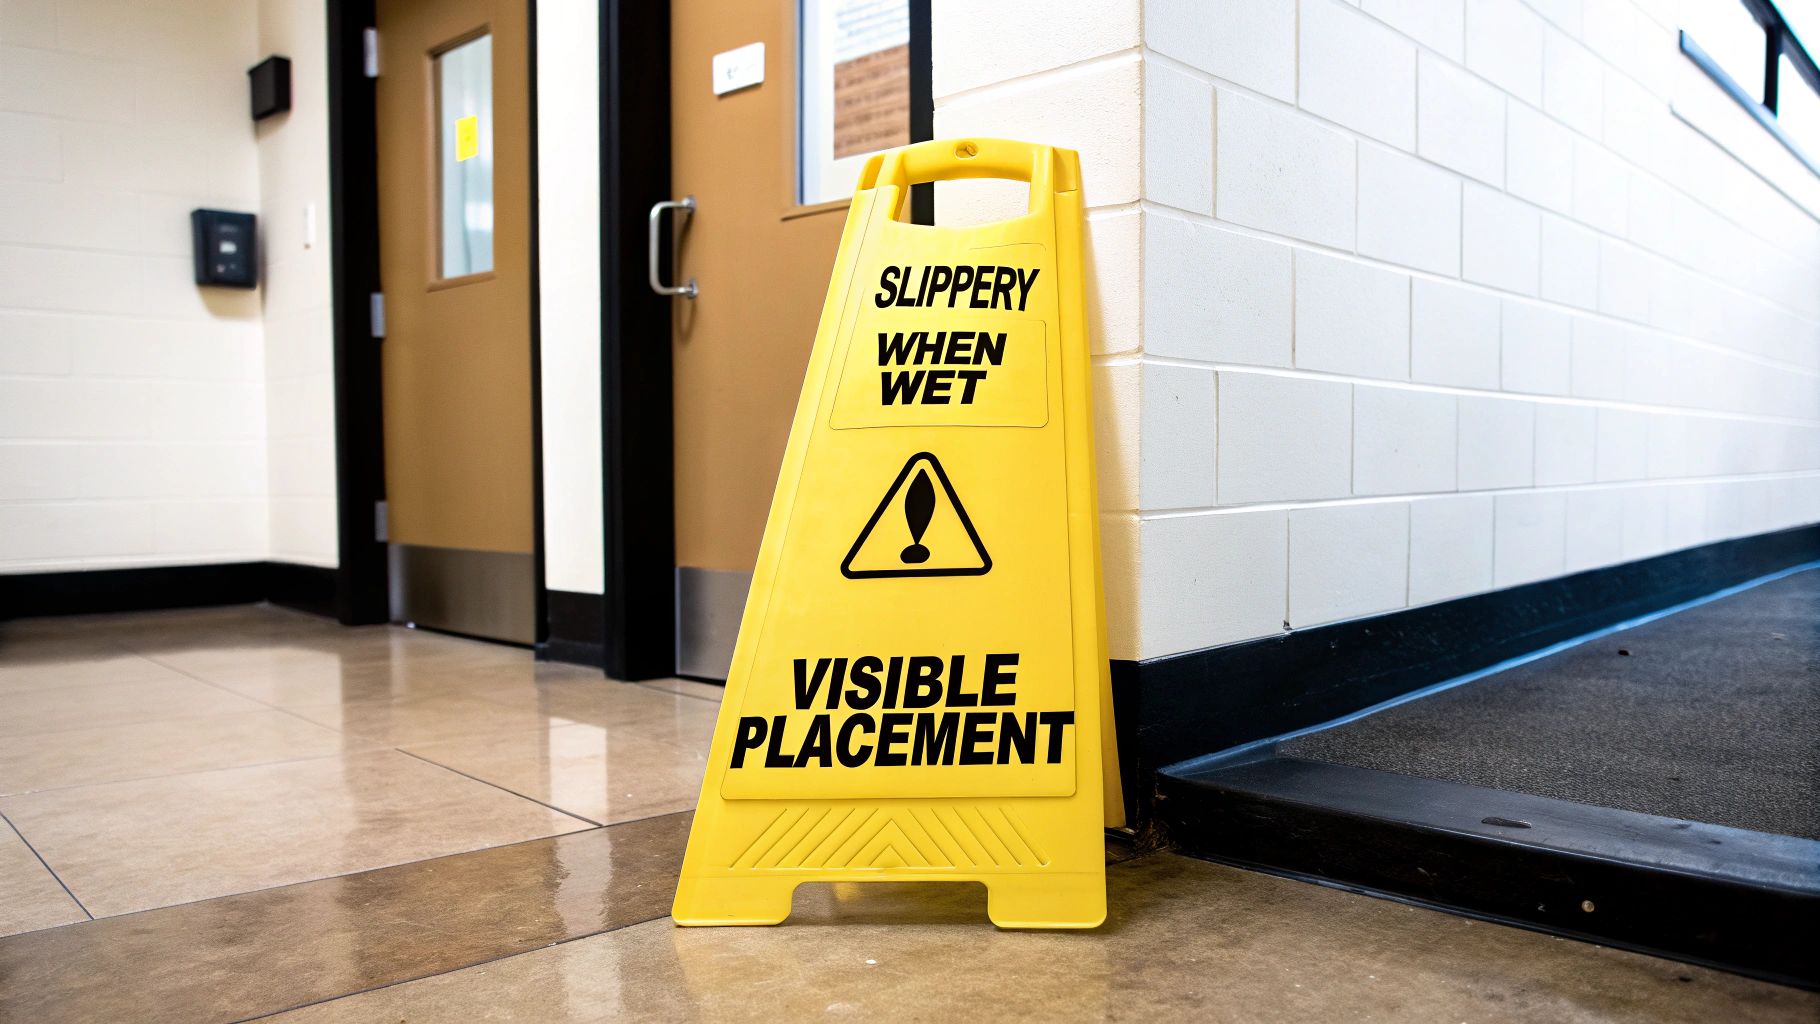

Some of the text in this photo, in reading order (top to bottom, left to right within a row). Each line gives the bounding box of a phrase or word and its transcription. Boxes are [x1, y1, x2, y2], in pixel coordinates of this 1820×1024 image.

[875, 266, 1040, 311] SLIPPERY
[878, 332, 1007, 366] WHEN
[882, 370, 987, 405] WET
[794, 654, 1019, 710] VISIBLE
[730, 711, 1074, 768] PLACEMENT
